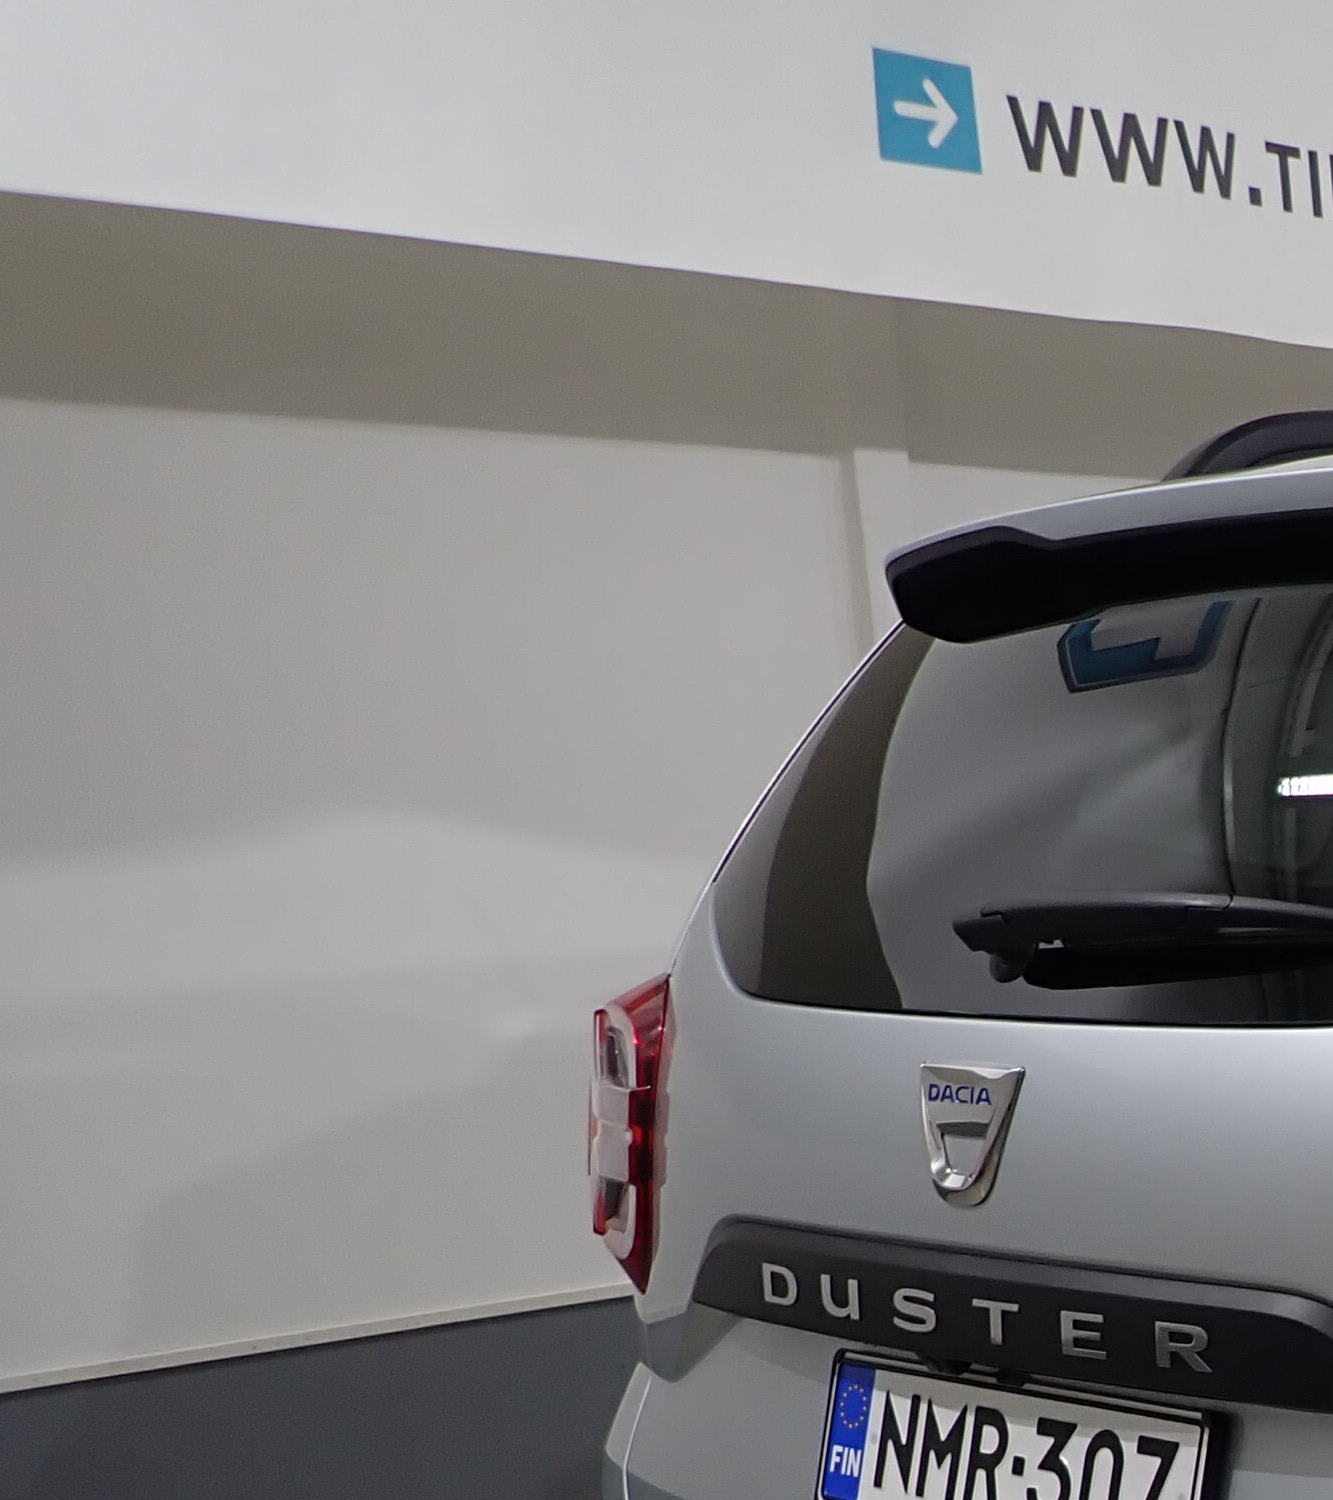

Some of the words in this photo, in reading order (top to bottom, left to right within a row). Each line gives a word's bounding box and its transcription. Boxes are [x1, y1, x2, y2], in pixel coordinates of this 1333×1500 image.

[927, 1082, 993, 1106] DACIA
[760, 1260, 1214, 1374] DUSTER
[829, 1444, 863, 1479] FIN
